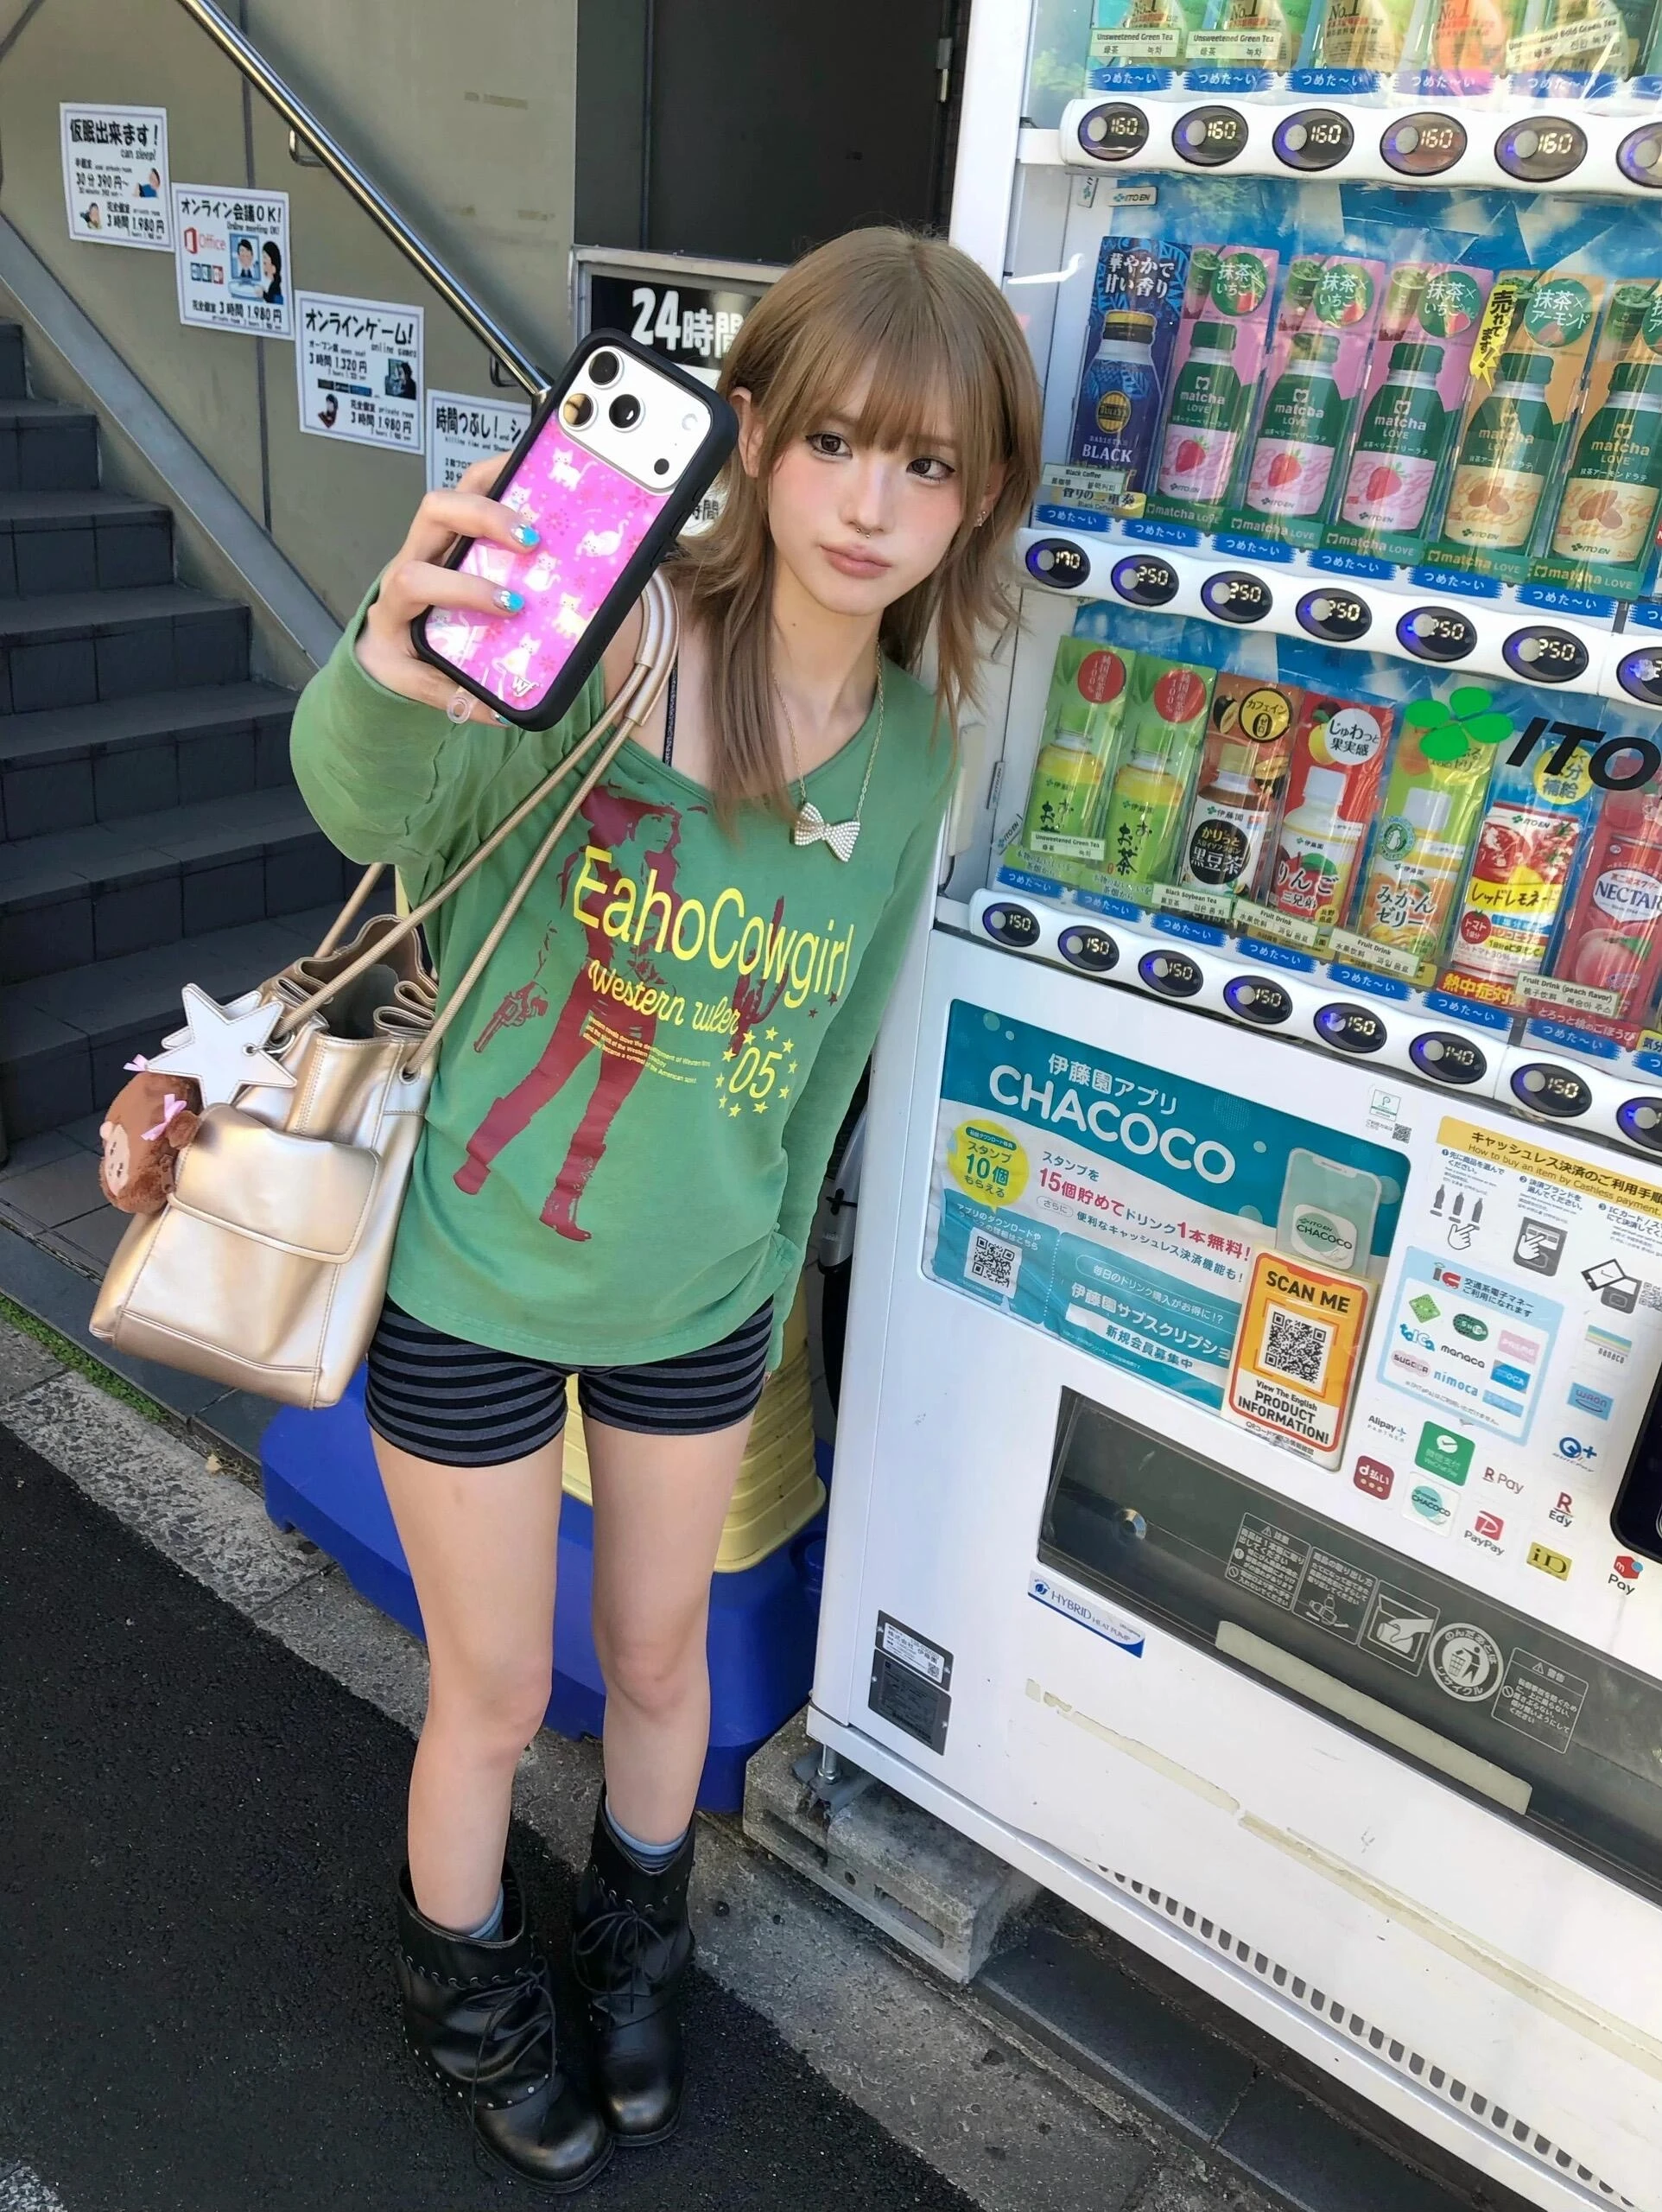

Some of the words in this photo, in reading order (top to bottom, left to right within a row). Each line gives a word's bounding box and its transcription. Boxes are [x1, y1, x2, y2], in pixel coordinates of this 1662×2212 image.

[1111, 118, 1139, 136] 160
[1207, 121, 1236, 140] 160
[1310, 124, 1342, 144] 160
[1420, 129, 1454, 149] 160
[1538, 132, 1574, 154] 160
[121, 149, 134, 159] can
[199, 234, 226, 251] Office
[1107, 252, 1175, 278] 華やかで
[1105, 274, 1168, 299] 甘い香り
[305, 308, 414, 345] オンラインゲーム!
[1531, 309, 1589, 329] アーモンド
[371, 343, 394, 355] online
[1180, 391, 1226, 405] matcha
[1187, 404, 1210, 414] LOVE
[1275, 404, 1324, 418] matcha
[1283, 416, 1308, 428] LOVE
[1374, 415, 1427, 431] matcha
[1382, 429, 1409, 440] LOVE
[1082, 444, 1133, 463] BLACK
[1156, 506, 1195, 520] matcha
[1243, 520, 1288, 537] matcha
[1291, 530, 1315, 540] LOVE
[1339, 536, 1386, 553] matcha
[1389, 545, 1415, 556] LOVE
[1138, 566, 1168, 585] 250
[1229, 582, 1261, 602] 250
[1246, 698, 1287, 715] カフェイン
[1329, 718, 1380, 744] じゅわっと
[1331, 737, 1369, 757] 果実感
[1506, 716, 1661, 791] ITO
[1216, 809, 1244, 822] 伊藤園
[1201, 828, 1241, 847] かりっと
[1190, 846, 1244, 876] 黒豆茶
[1278, 861, 1340, 895] りんご
[1166, 888, 1181, 898] Black
[1182, 892, 1206, 903] Soybean
[1281, 893, 1316, 910] 三兄弟
[1377, 885, 1436, 914] みかん
[574, 845, 854, 1008] EahoCowgirl
[1008, 914, 1031, 931] 150
[1260, 910, 1274, 920] Fruit
[1275, 914, 1292, 926] Drink
[1376, 907, 1424, 928] ゼリー
[1466, 918, 1488, 931] トマト
[1087, 937, 1110, 955] 150
[1357, 939, 1373, 950] Fruit
[1373, 944, 1392, 956] Drink
[1168, 962, 1194, 981] 150
[587, 959, 685, 1026] Western
[1254, 988, 1282, 1007] 150
[1522, 976, 1539, 986] Fruit
[1541, 979, 1560, 990] Drink
[1562, 984, 1587, 998] (peach
[1588, 989, 1613, 1003] flavor)
[1348, 1015, 1376, 1036] 150
[1445, 1046, 1475, 1066] 140
[728, 1046, 783, 1099] 05
[1048, 1052, 1177, 1116] 伊藤園アプリ
[1547, 1077, 1580, 1099] 150
[989, 1065, 1236, 1184] CHACOCO
[967, 1141, 1012, 1164] スタンプ
[966, 1154, 1010, 1187] 10個
[1043, 1151, 1100, 1182] スタンプを
[964, 1174, 1005, 1198] もらえる
[1469, 1144, 1488, 1156] How
[1491, 1150, 1500, 1160] to
[1502, 1154, 1519, 1169] buy
[1522, 1163, 1534, 1172] an
[1536, 1165, 1557, 1180] item
[1560, 1174, 1571, 1187] by
[1573, 1179, 1614, 1200] Cashless
[1616, 1194, 1661, 1217] payment.
[1044, 1198, 1068, 1214] さらに
[1296, 1223, 1353, 1250] CHACOCO
[1266, 1270, 1316, 1303] SCAN
[1320, 1290, 1350, 1313] ME
[1462, 1285, 1533, 1319] ご利用になれます
[1464, 1277, 1534, 1308] 交通系電子マネー
[1106, 1325, 1194, 1370] 新規会員募集中
[1441, 1344, 1486, 1370] manaca
[1433, 1370, 1479, 1397] nimoca
[1256, 1380, 1274, 1393] View
[1276, 1388, 1289, 1399] The
[1291, 1394, 1317, 1411] English
[1254, 1390, 1316, 1424] PRODUCT
[1238, 1395, 1329, 1445] INFORMATION!
[1368, 1414, 1397, 1434] Alipay
[1496, 1470, 1525, 1495] Pay
[1411, 1493, 1451, 1517] CHACOCO
[1549, 1510, 1572, 1528] Edy
[1464, 1529, 1505, 1556] PayPay
[1532, 1547, 1568, 1574] iD
[1608, 1573, 1635, 1596] Pay
[1051, 1590, 1093, 1621] HYBRID
[1092, 1616, 1111, 1631] HEAT
[1111, 1626, 1132, 1643] PUMP
